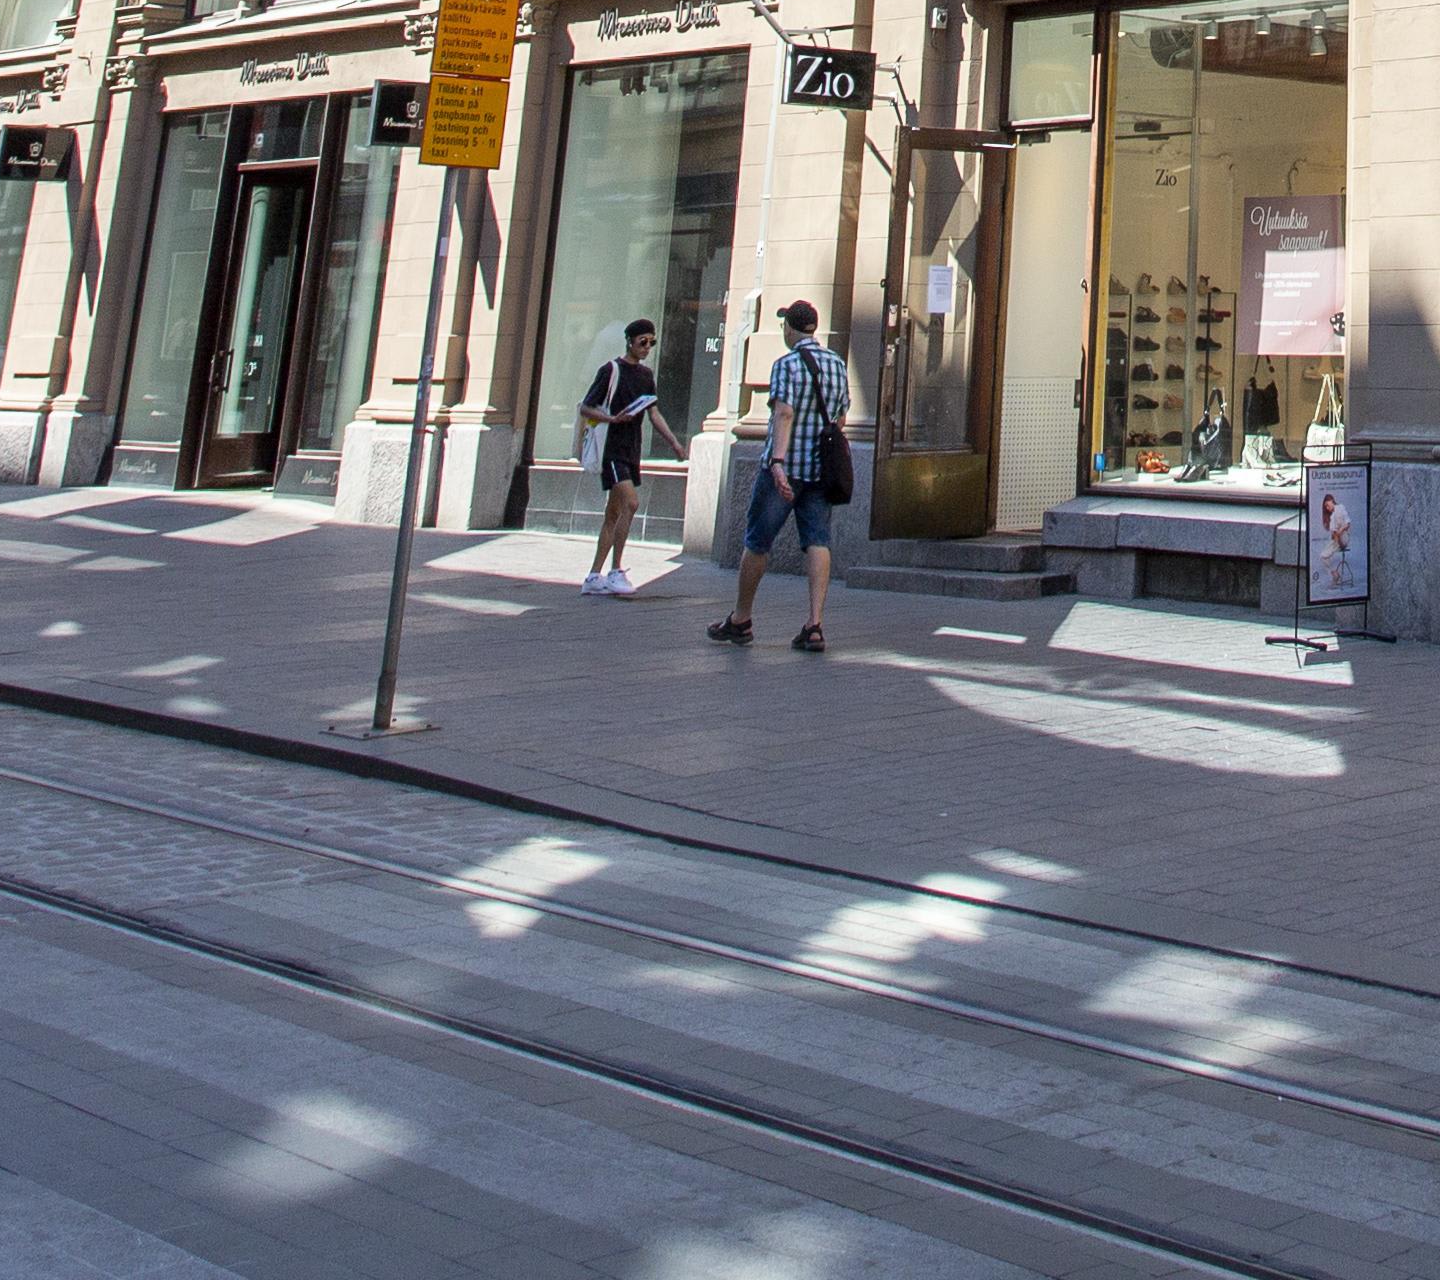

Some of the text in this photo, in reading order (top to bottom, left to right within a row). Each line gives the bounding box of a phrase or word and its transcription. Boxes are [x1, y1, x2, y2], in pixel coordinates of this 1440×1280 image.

[793, 54, 855, 99] Zio
[1154, 168, 1178, 186] Zio
[1250, 205, 1309, 236] Uutuuksia
